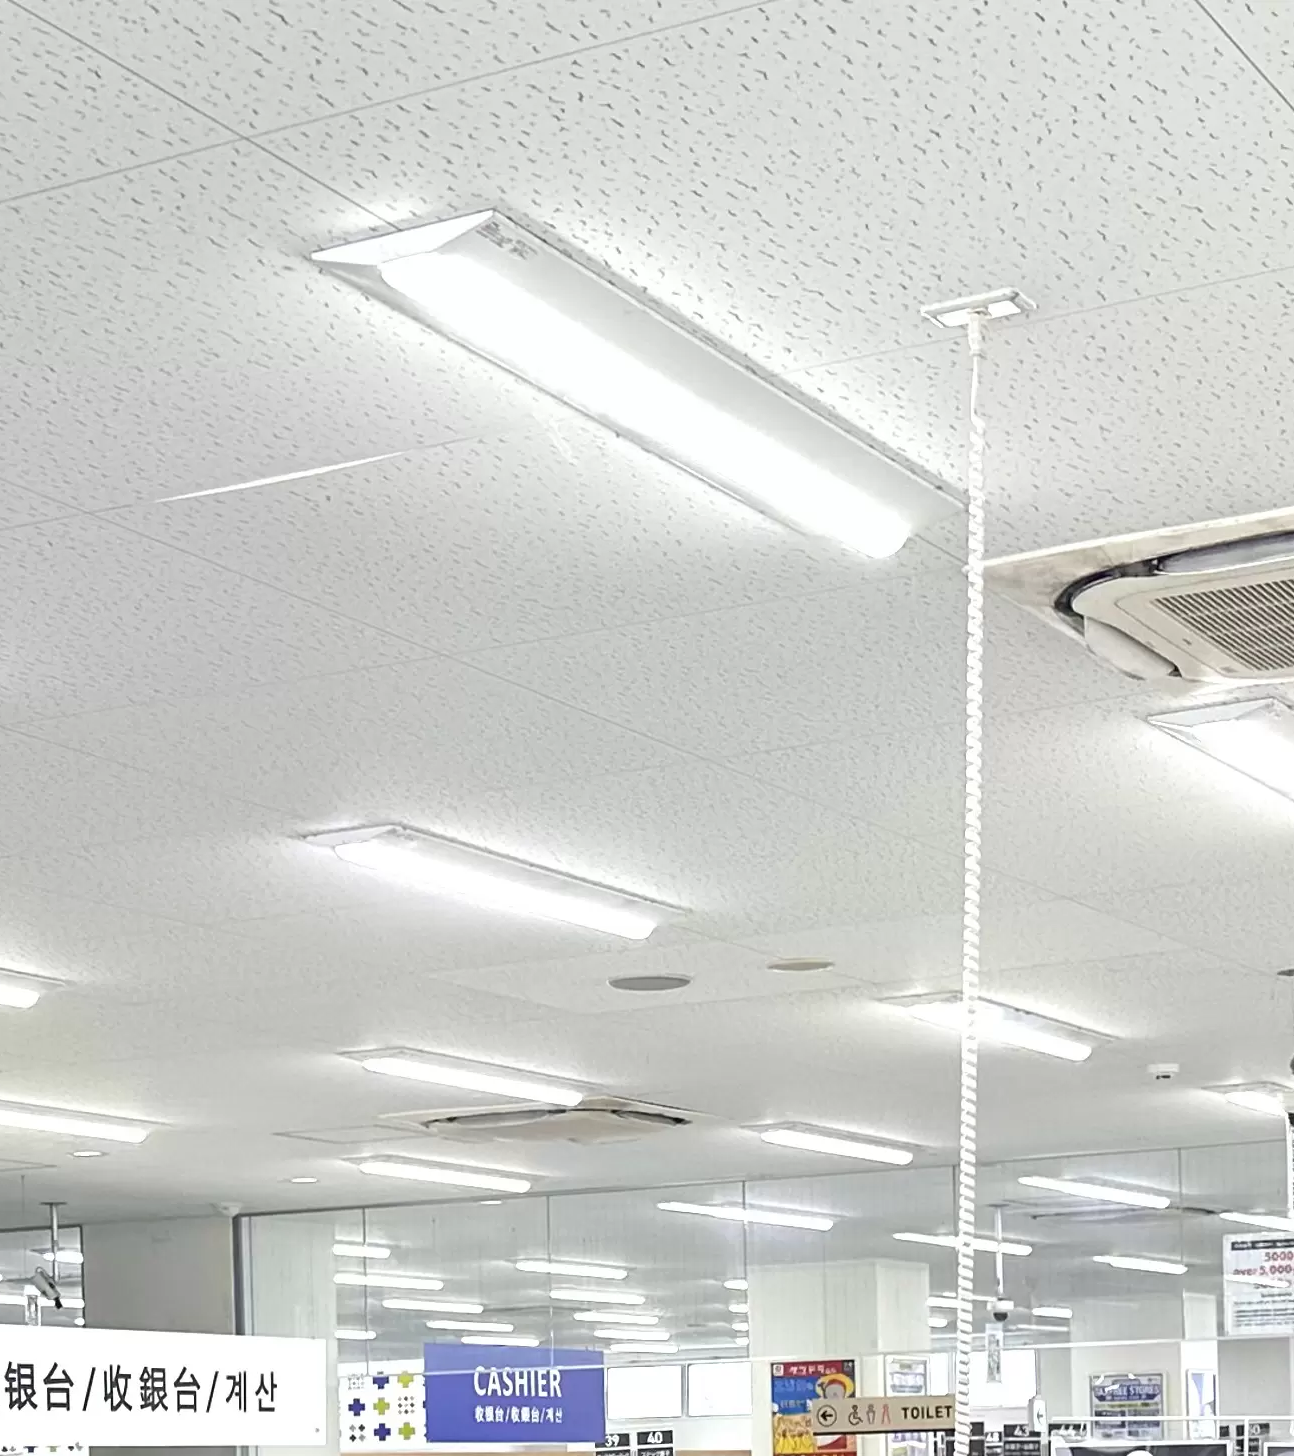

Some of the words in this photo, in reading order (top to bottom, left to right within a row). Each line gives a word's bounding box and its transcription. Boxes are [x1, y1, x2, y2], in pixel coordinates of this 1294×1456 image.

[473, 1365, 563, 1398] CASHIER
[901, 1404, 954, 1421] TOILET
[646, 1431, 663, 1444] 40
